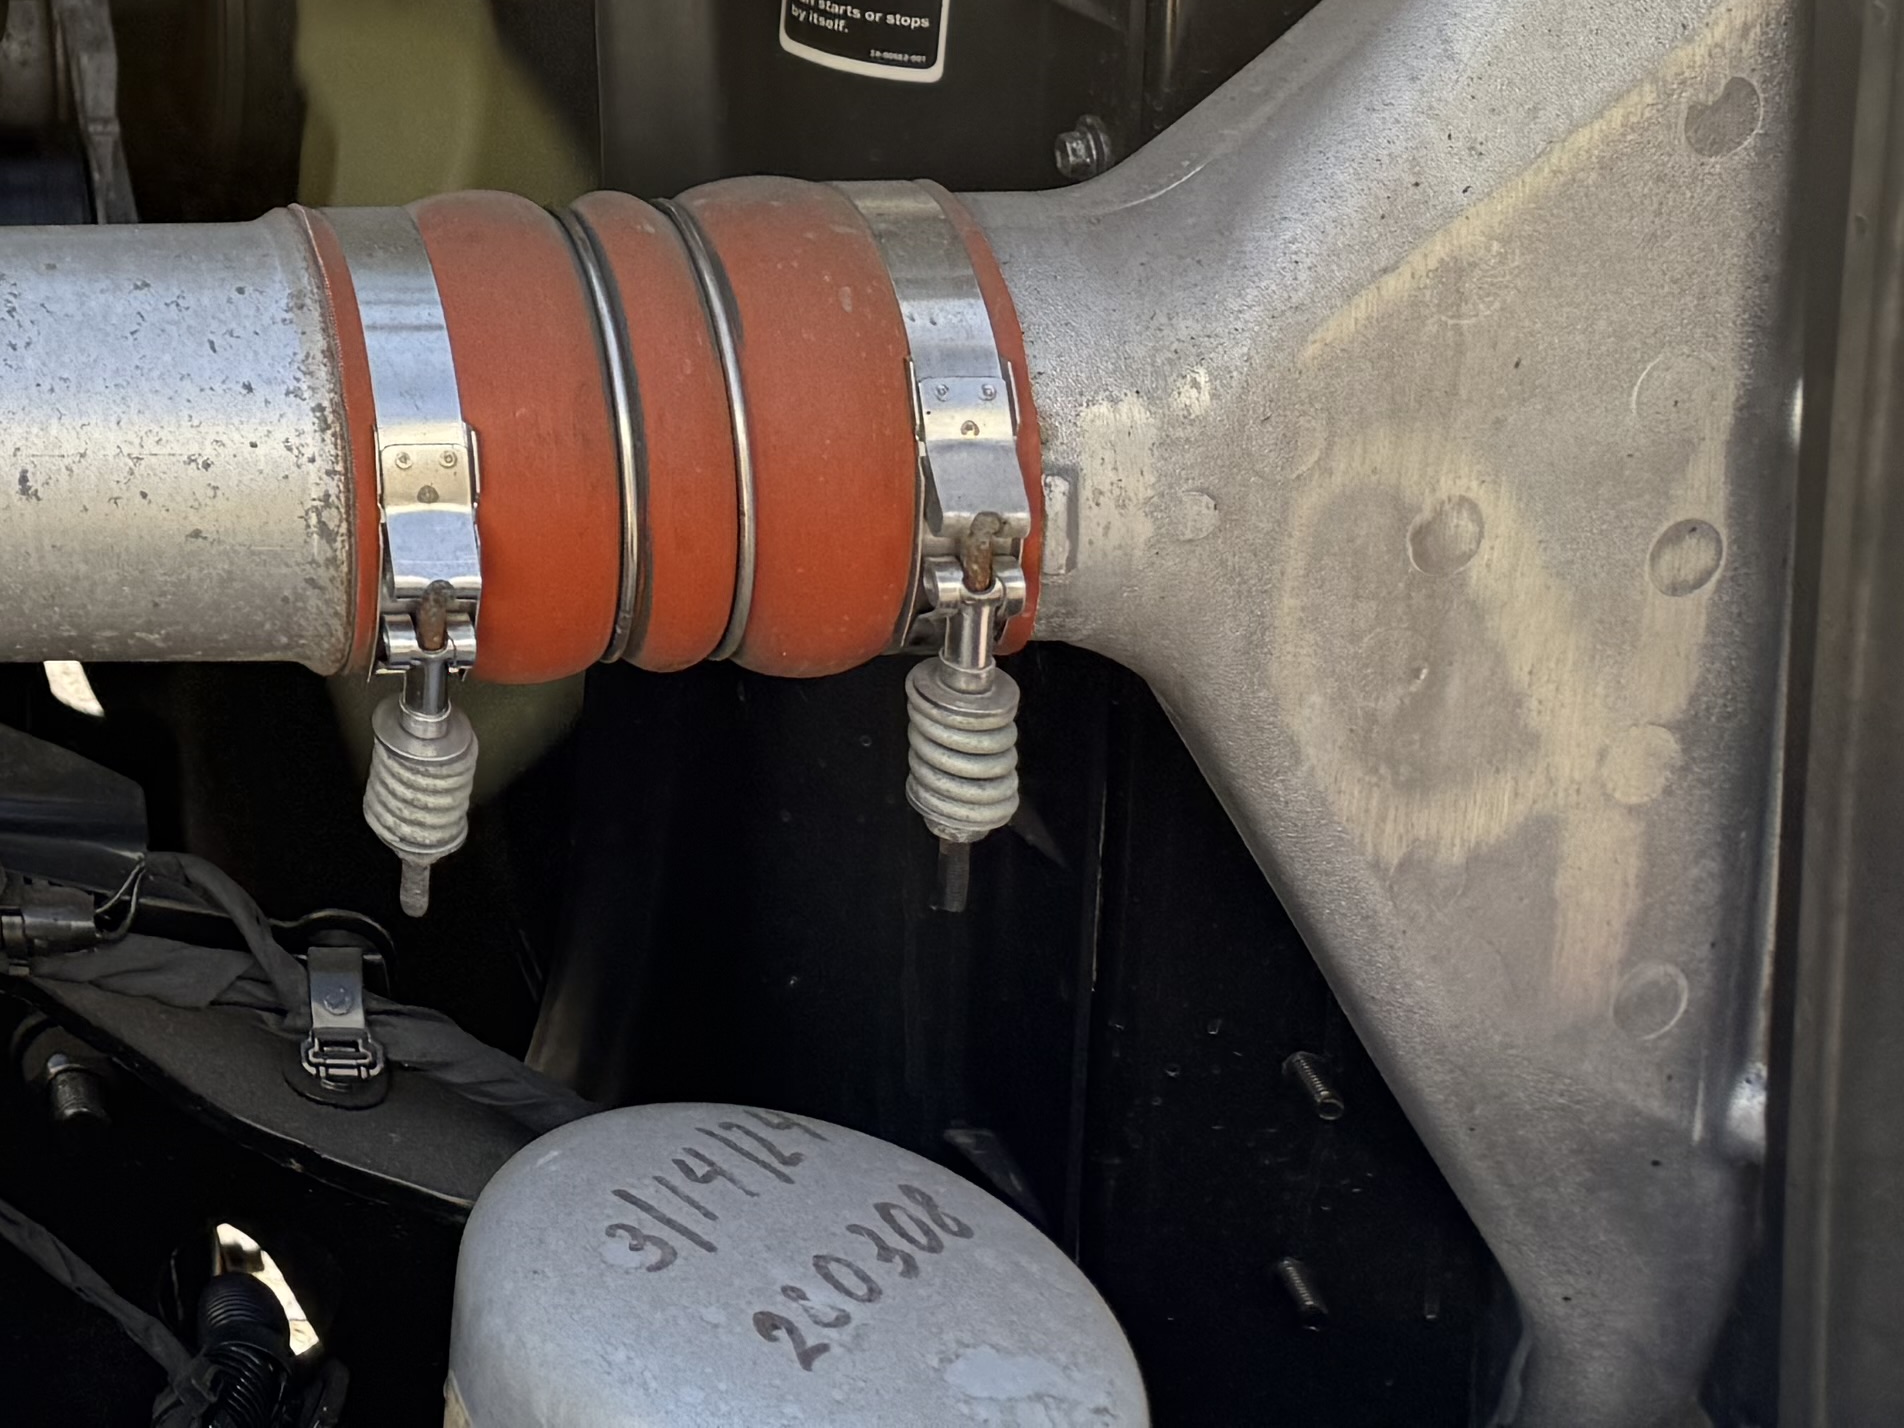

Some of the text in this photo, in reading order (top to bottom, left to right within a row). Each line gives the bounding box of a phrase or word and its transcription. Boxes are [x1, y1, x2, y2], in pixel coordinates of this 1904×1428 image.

[791, 3, 849, 33] by itself.
[818, 0, 861, 19] starts
[865, 11, 884, 23] or
[886, 13, 930, 30] stops
[604, 1109, 830, 1273] 3/14/24
